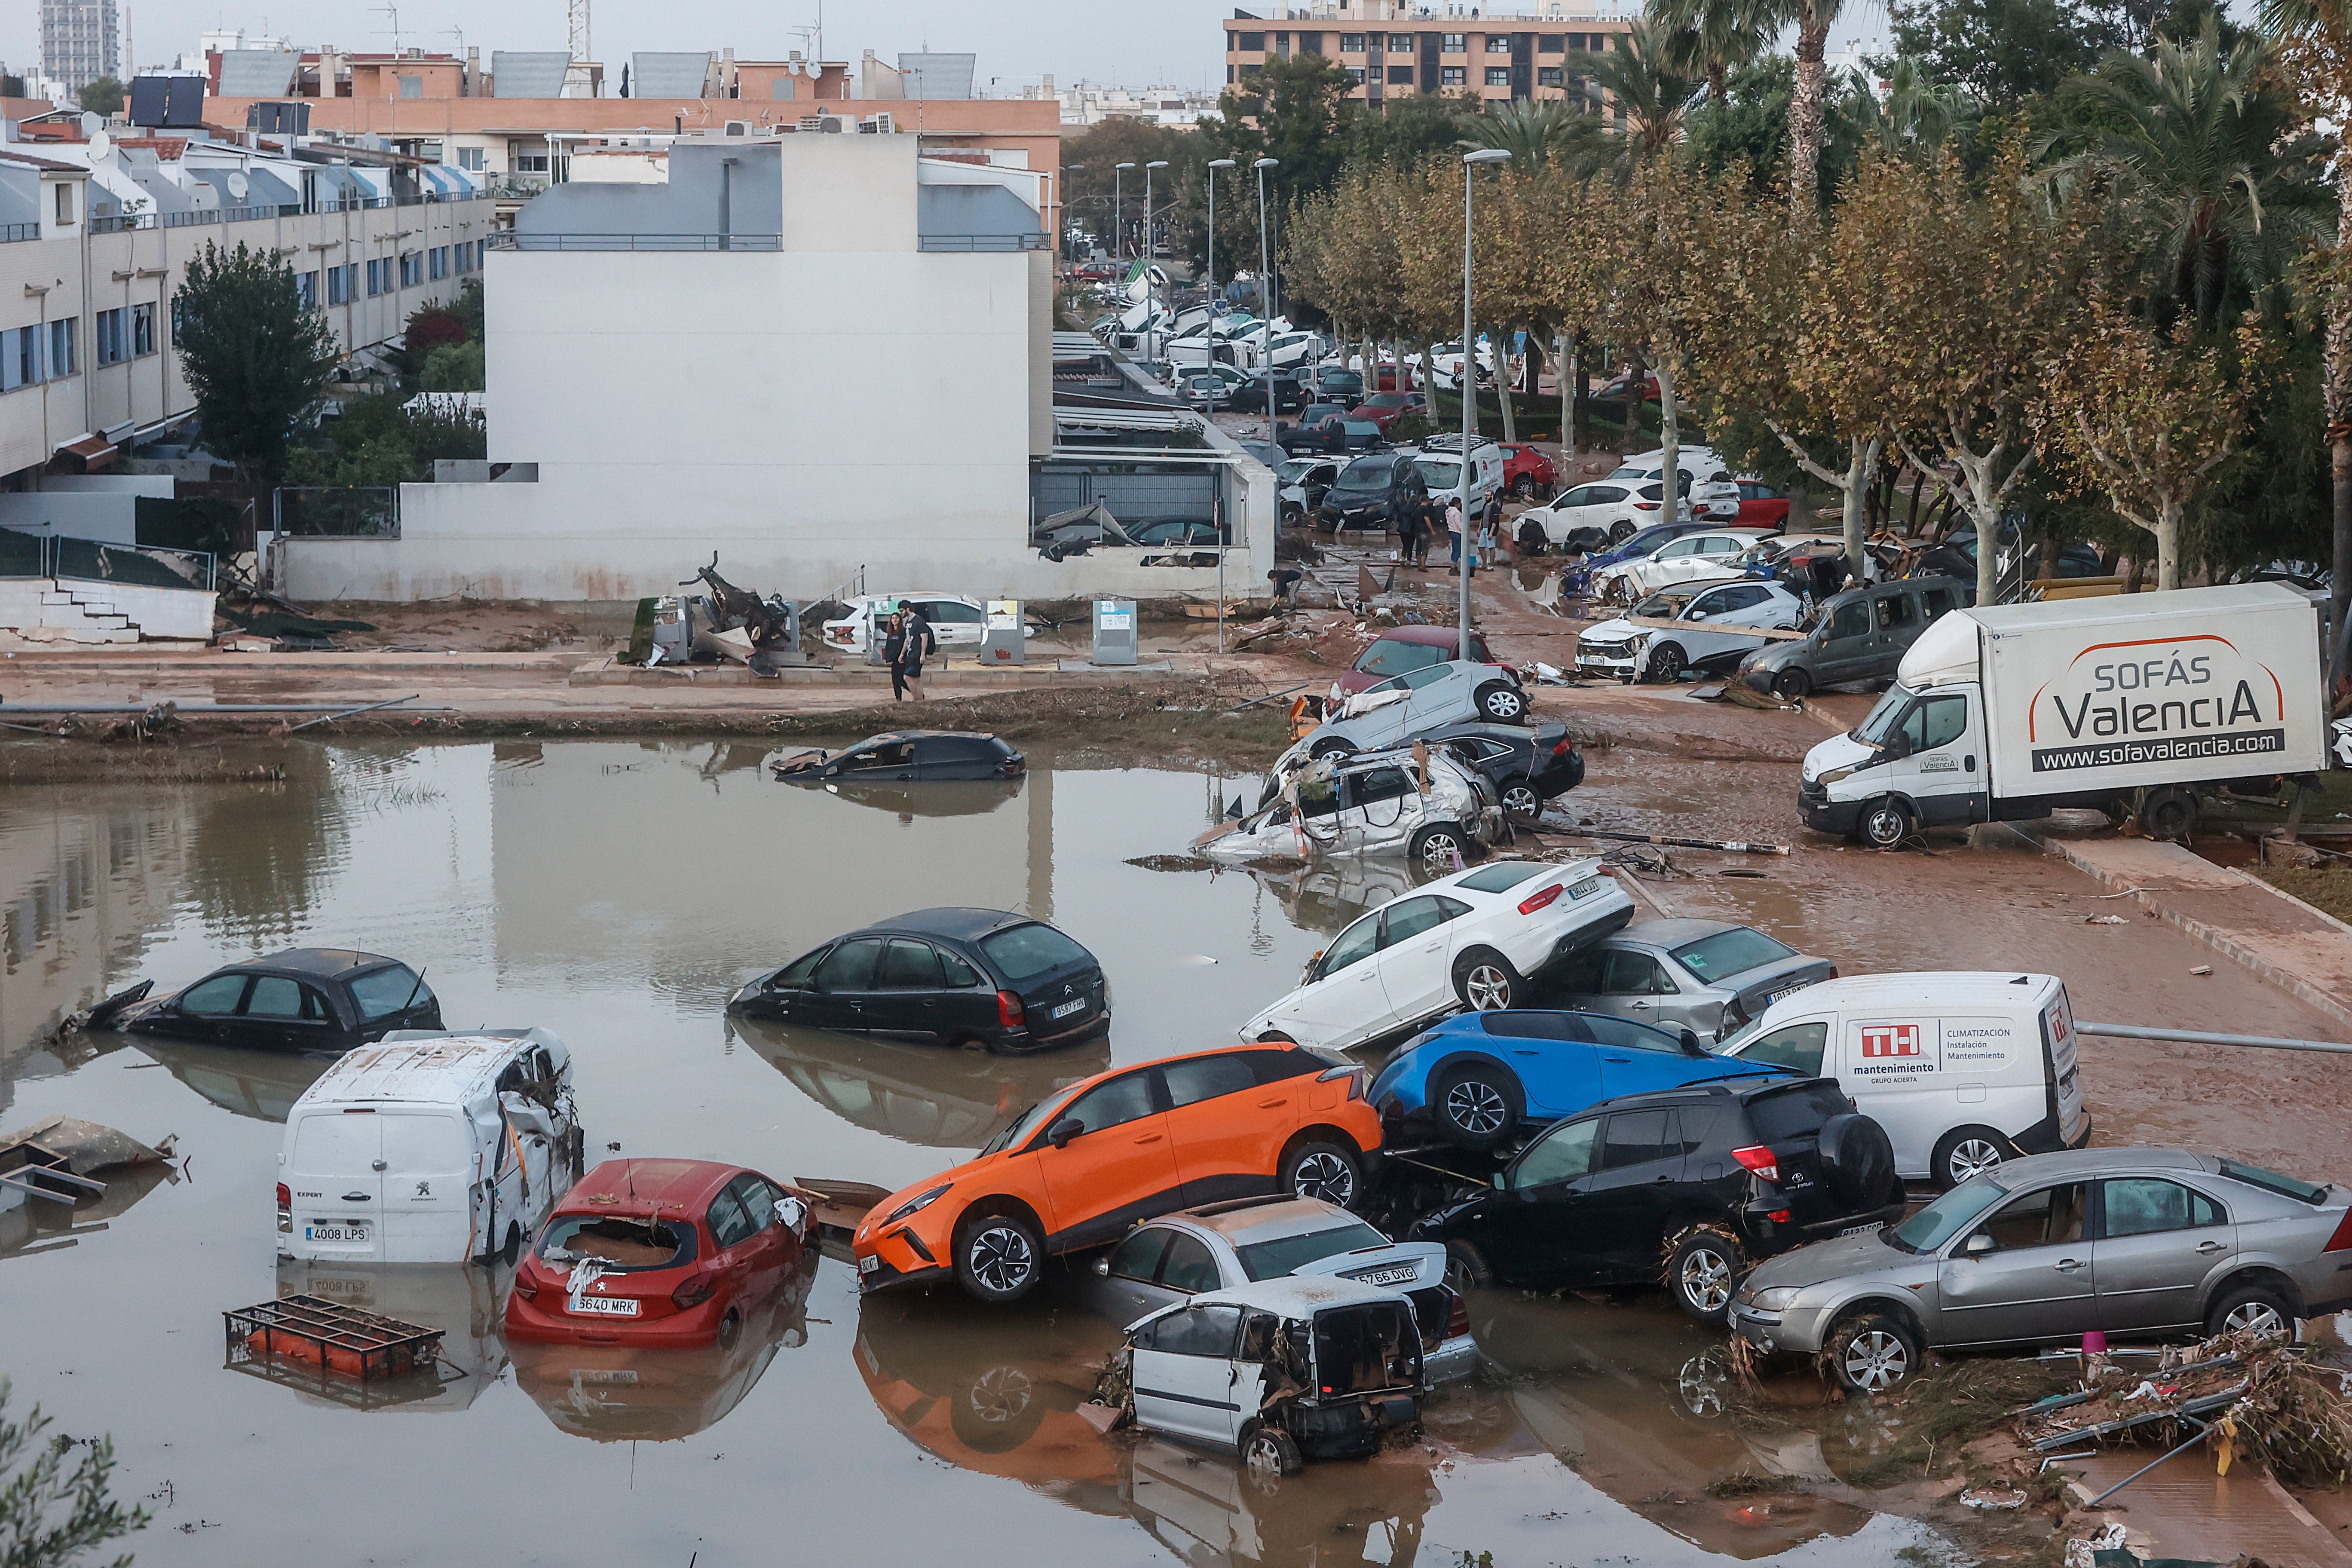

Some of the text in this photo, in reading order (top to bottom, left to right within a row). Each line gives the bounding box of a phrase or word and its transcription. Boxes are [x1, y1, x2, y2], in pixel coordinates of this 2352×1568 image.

[2095, 649, 2210, 692] SOFÁS
[2041, 734, 2276, 770] www.sofavalencia.com
[1573, 880, 1598, 897] 3644 JJT
[1057, 998, 1084, 1015] 9587 FHN
[1863, 1026, 1918, 1056] TH
[1947, 1029, 2010, 1038] CLIMATIZACIÓN
[1947, 1041, 1987, 1049] Instalación
[1854, 1063, 1934, 1075] mantenimiento
[315, 1229, 364, 1240] 4008 LPS
[1359, 1269, 1413, 1284] 5766 DVG
[612, 1300, 634, 1312] MRK
